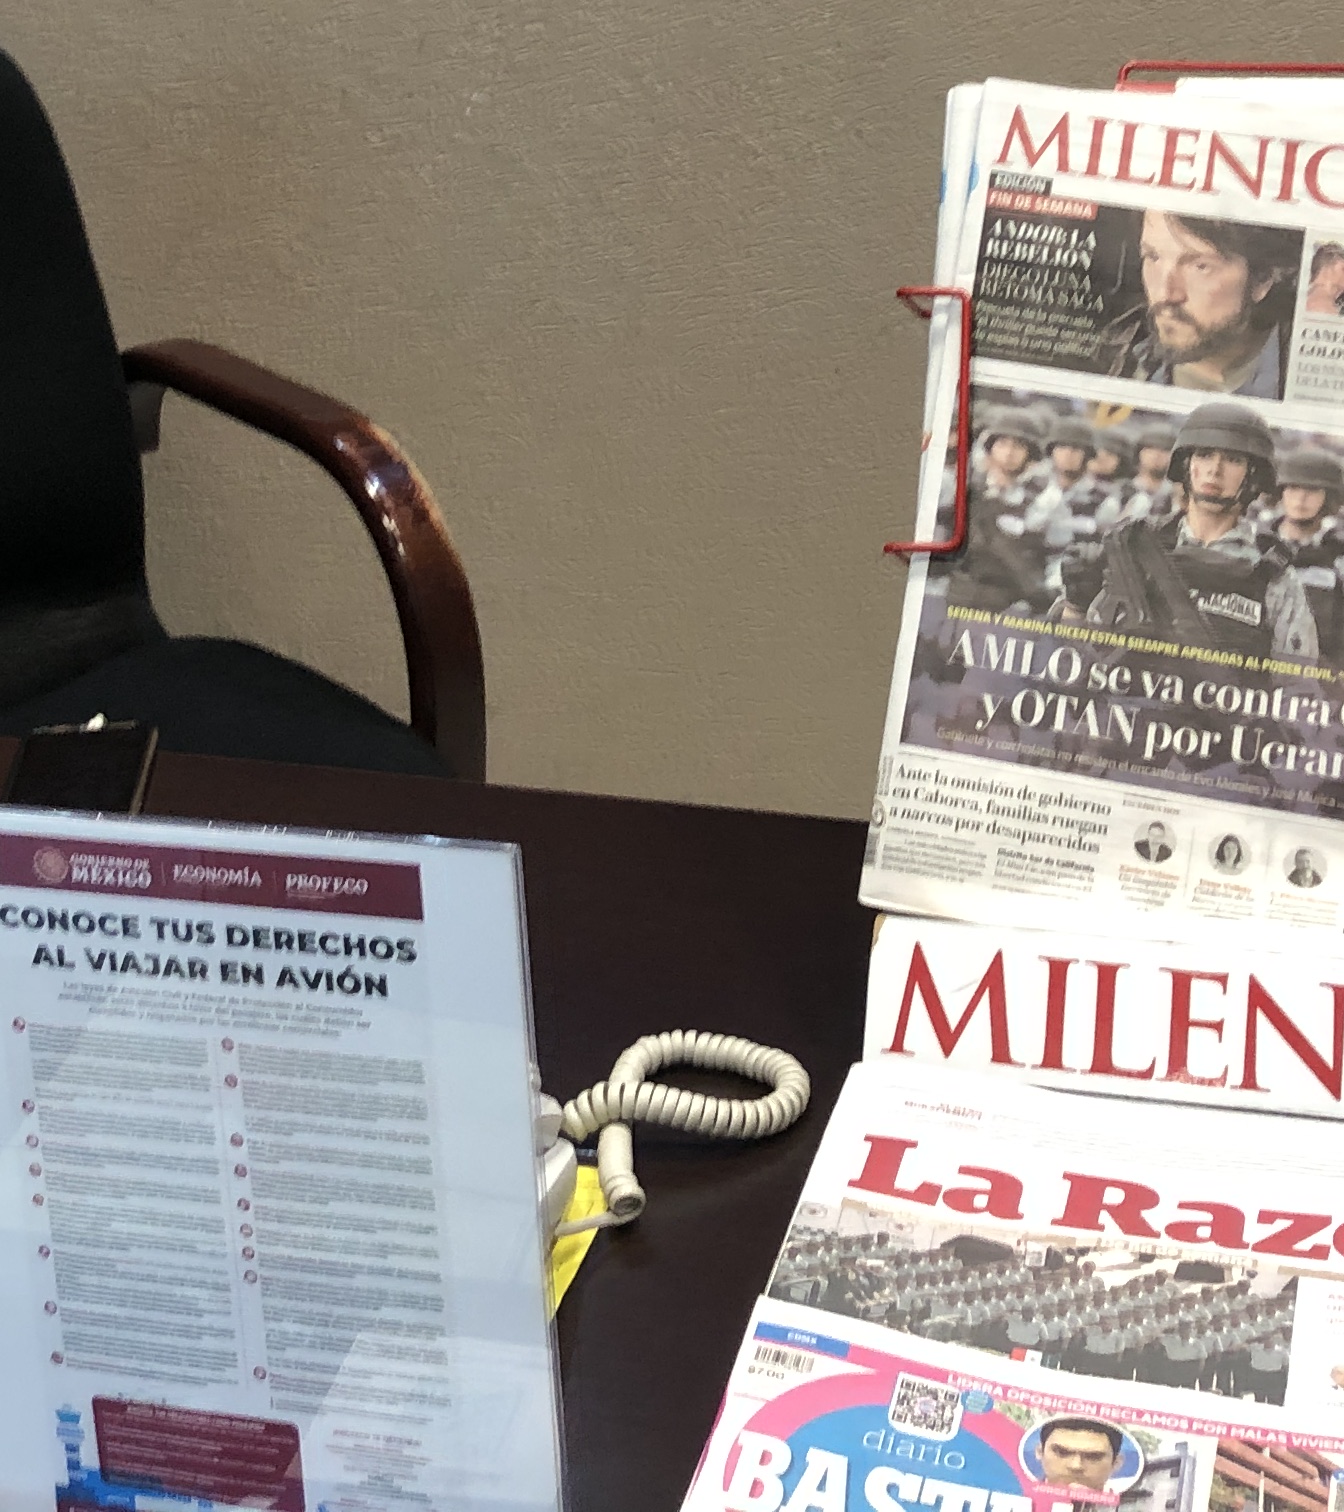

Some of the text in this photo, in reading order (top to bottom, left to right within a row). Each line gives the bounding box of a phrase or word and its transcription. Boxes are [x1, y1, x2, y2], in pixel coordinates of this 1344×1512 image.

[989, 188, 1093, 219] FIN DE SEMANA
[947, 605, 991, 625] SEDENA
[994, 613, 1001, 627] Y
[1003, 614, 1053, 635] MARINA
[1056, 623, 1091, 642] DICEN
[1092, 629, 1126, 648] ESTAR
[1128, 635, 1180, 656] SIEMPRE
[1181, 645, 1243, 668] APEGADAS
[1244, 656, 1261, 671] AL
[1262, 658, 1300, 676] PODER
[946, 629, 1082, 686] AMLO
[1087, 661, 1132, 695] se
[1141, 669, 1184, 705] va
[1193, 681, 1331, 728] contra
[975, 692, 1004, 731] y
[1011, 688, 1141, 746] OTAN
[1143, 720, 1222, 761] por
[897, 762, 932, 783] Ante
[934, 768, 948, 786] la
[950, 771, 1014, 798] omisión
[1016, 784, 1036, 802] de
[1038, 790, 1112, 817] gobierno
[1194, 773, 1214, 787] Evo
[892, 785, 910, 799] en
[986, 798, 1049, 825] familias
[1051, 814, 1108, 838] ruegan
[900, 806, 954, 828] narcos
[955, 816, 984, 836] por
[985, 821, 1100, 855] desaparecidos
[70, 852, 151, 871] GOBIERNO DE
[172, 862, 263, 888] ECONOMÍA
[285, 872, 369, 896] PROFECO
[151, 915, 216, 946] TUS
[225, 923, 419, 965] DERECHOS
[31, 943, 391, 999] AL VIAJAR EN AVIÓN
[847, 1133, 1024, 1221] La
[947, 1373, 1004, 1398] LIDERA
[1006, 1387, 1097, 1415] OPOSICIÓN
[1100, 1405, 1189, 1431] RECLAMOS
[1192, 1420, 1228, 1435] POR
[1230, 1425, 1287, 1444] MALAS
[722, 1430, 1033, 1512] BAS
[862, 1429, 966, 1470] diario
